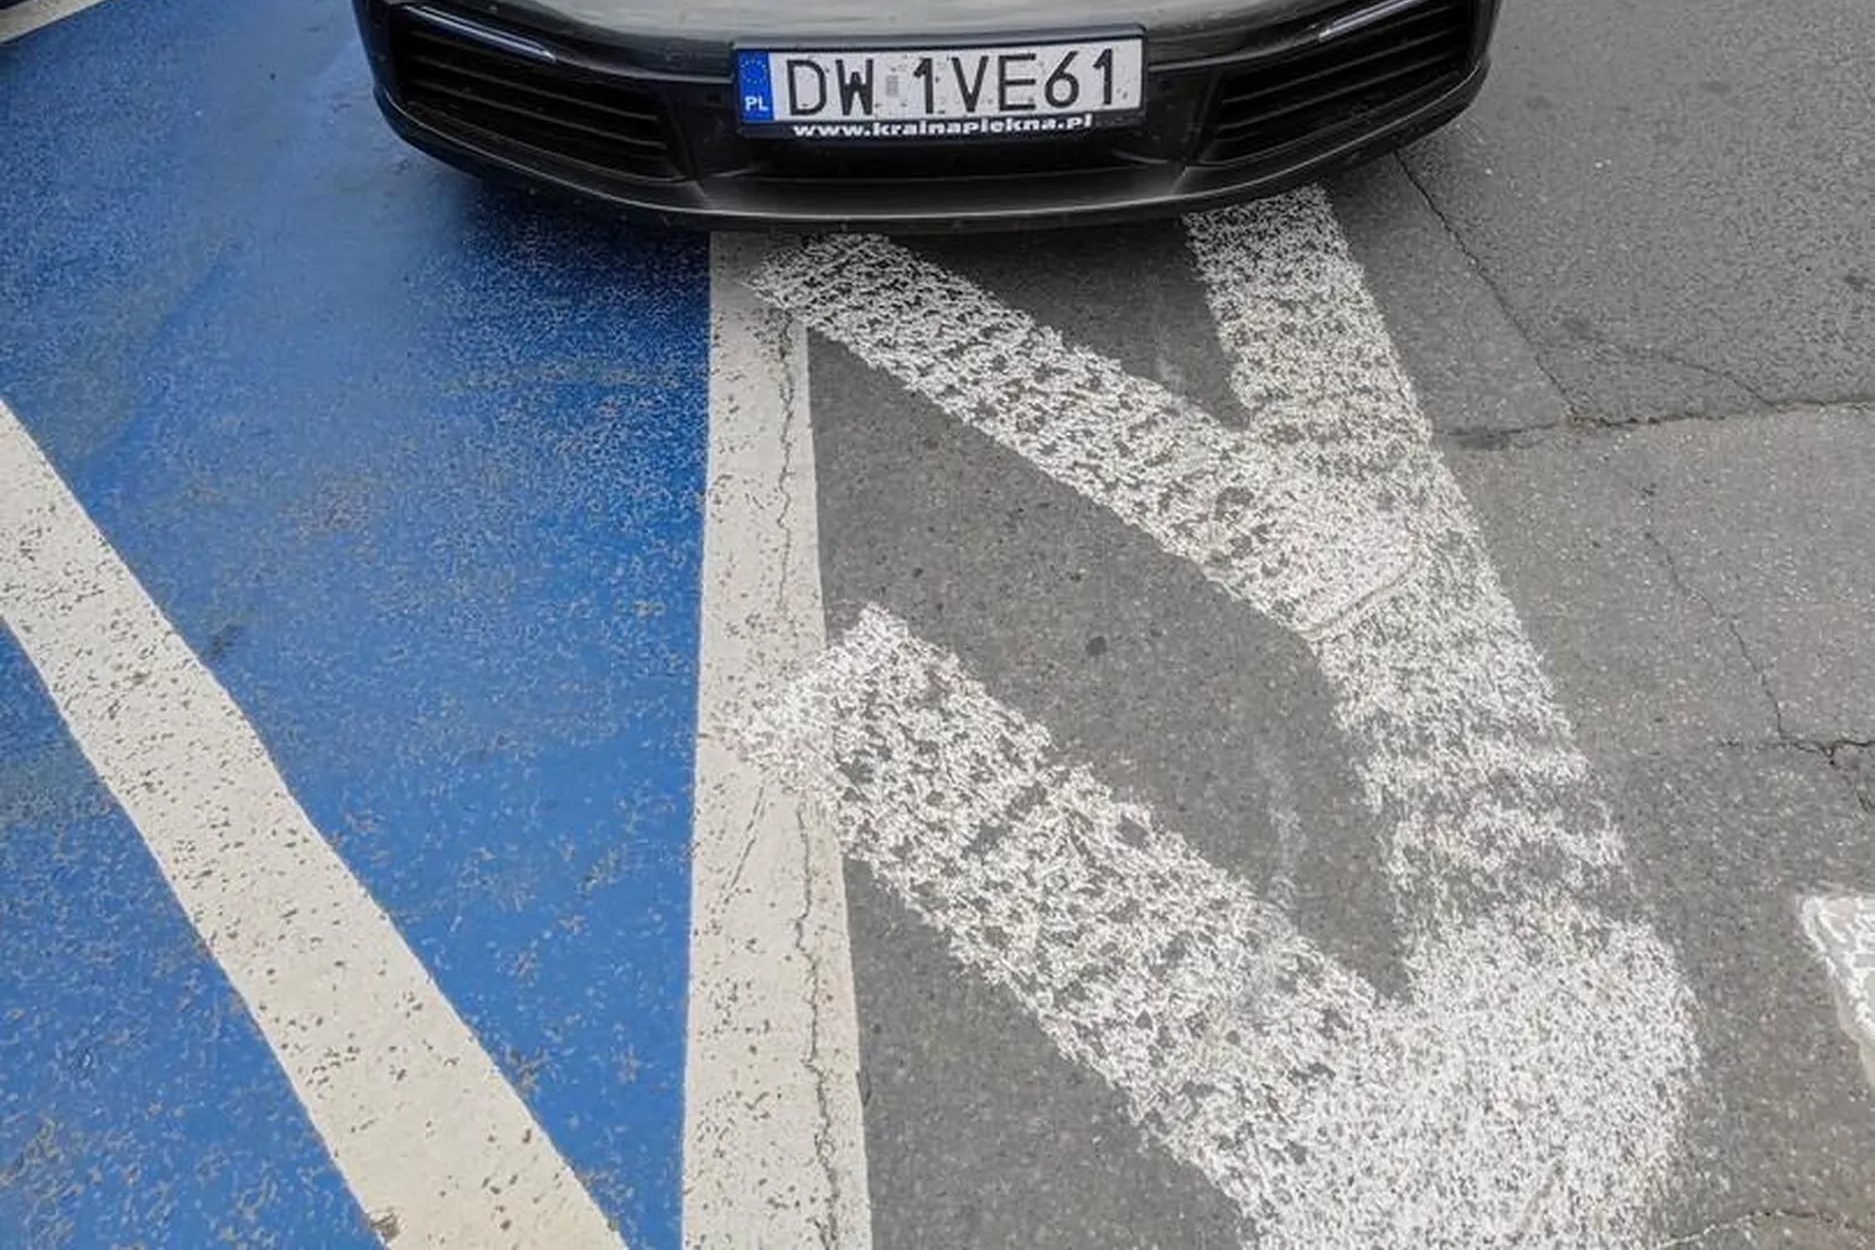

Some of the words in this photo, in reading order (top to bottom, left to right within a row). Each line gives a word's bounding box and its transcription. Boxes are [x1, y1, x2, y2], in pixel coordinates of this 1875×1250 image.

[744, 95, 770, 111] PL
[786, 57, 874, 117] DW
[912, 48, 1115, 115] 1VE61
